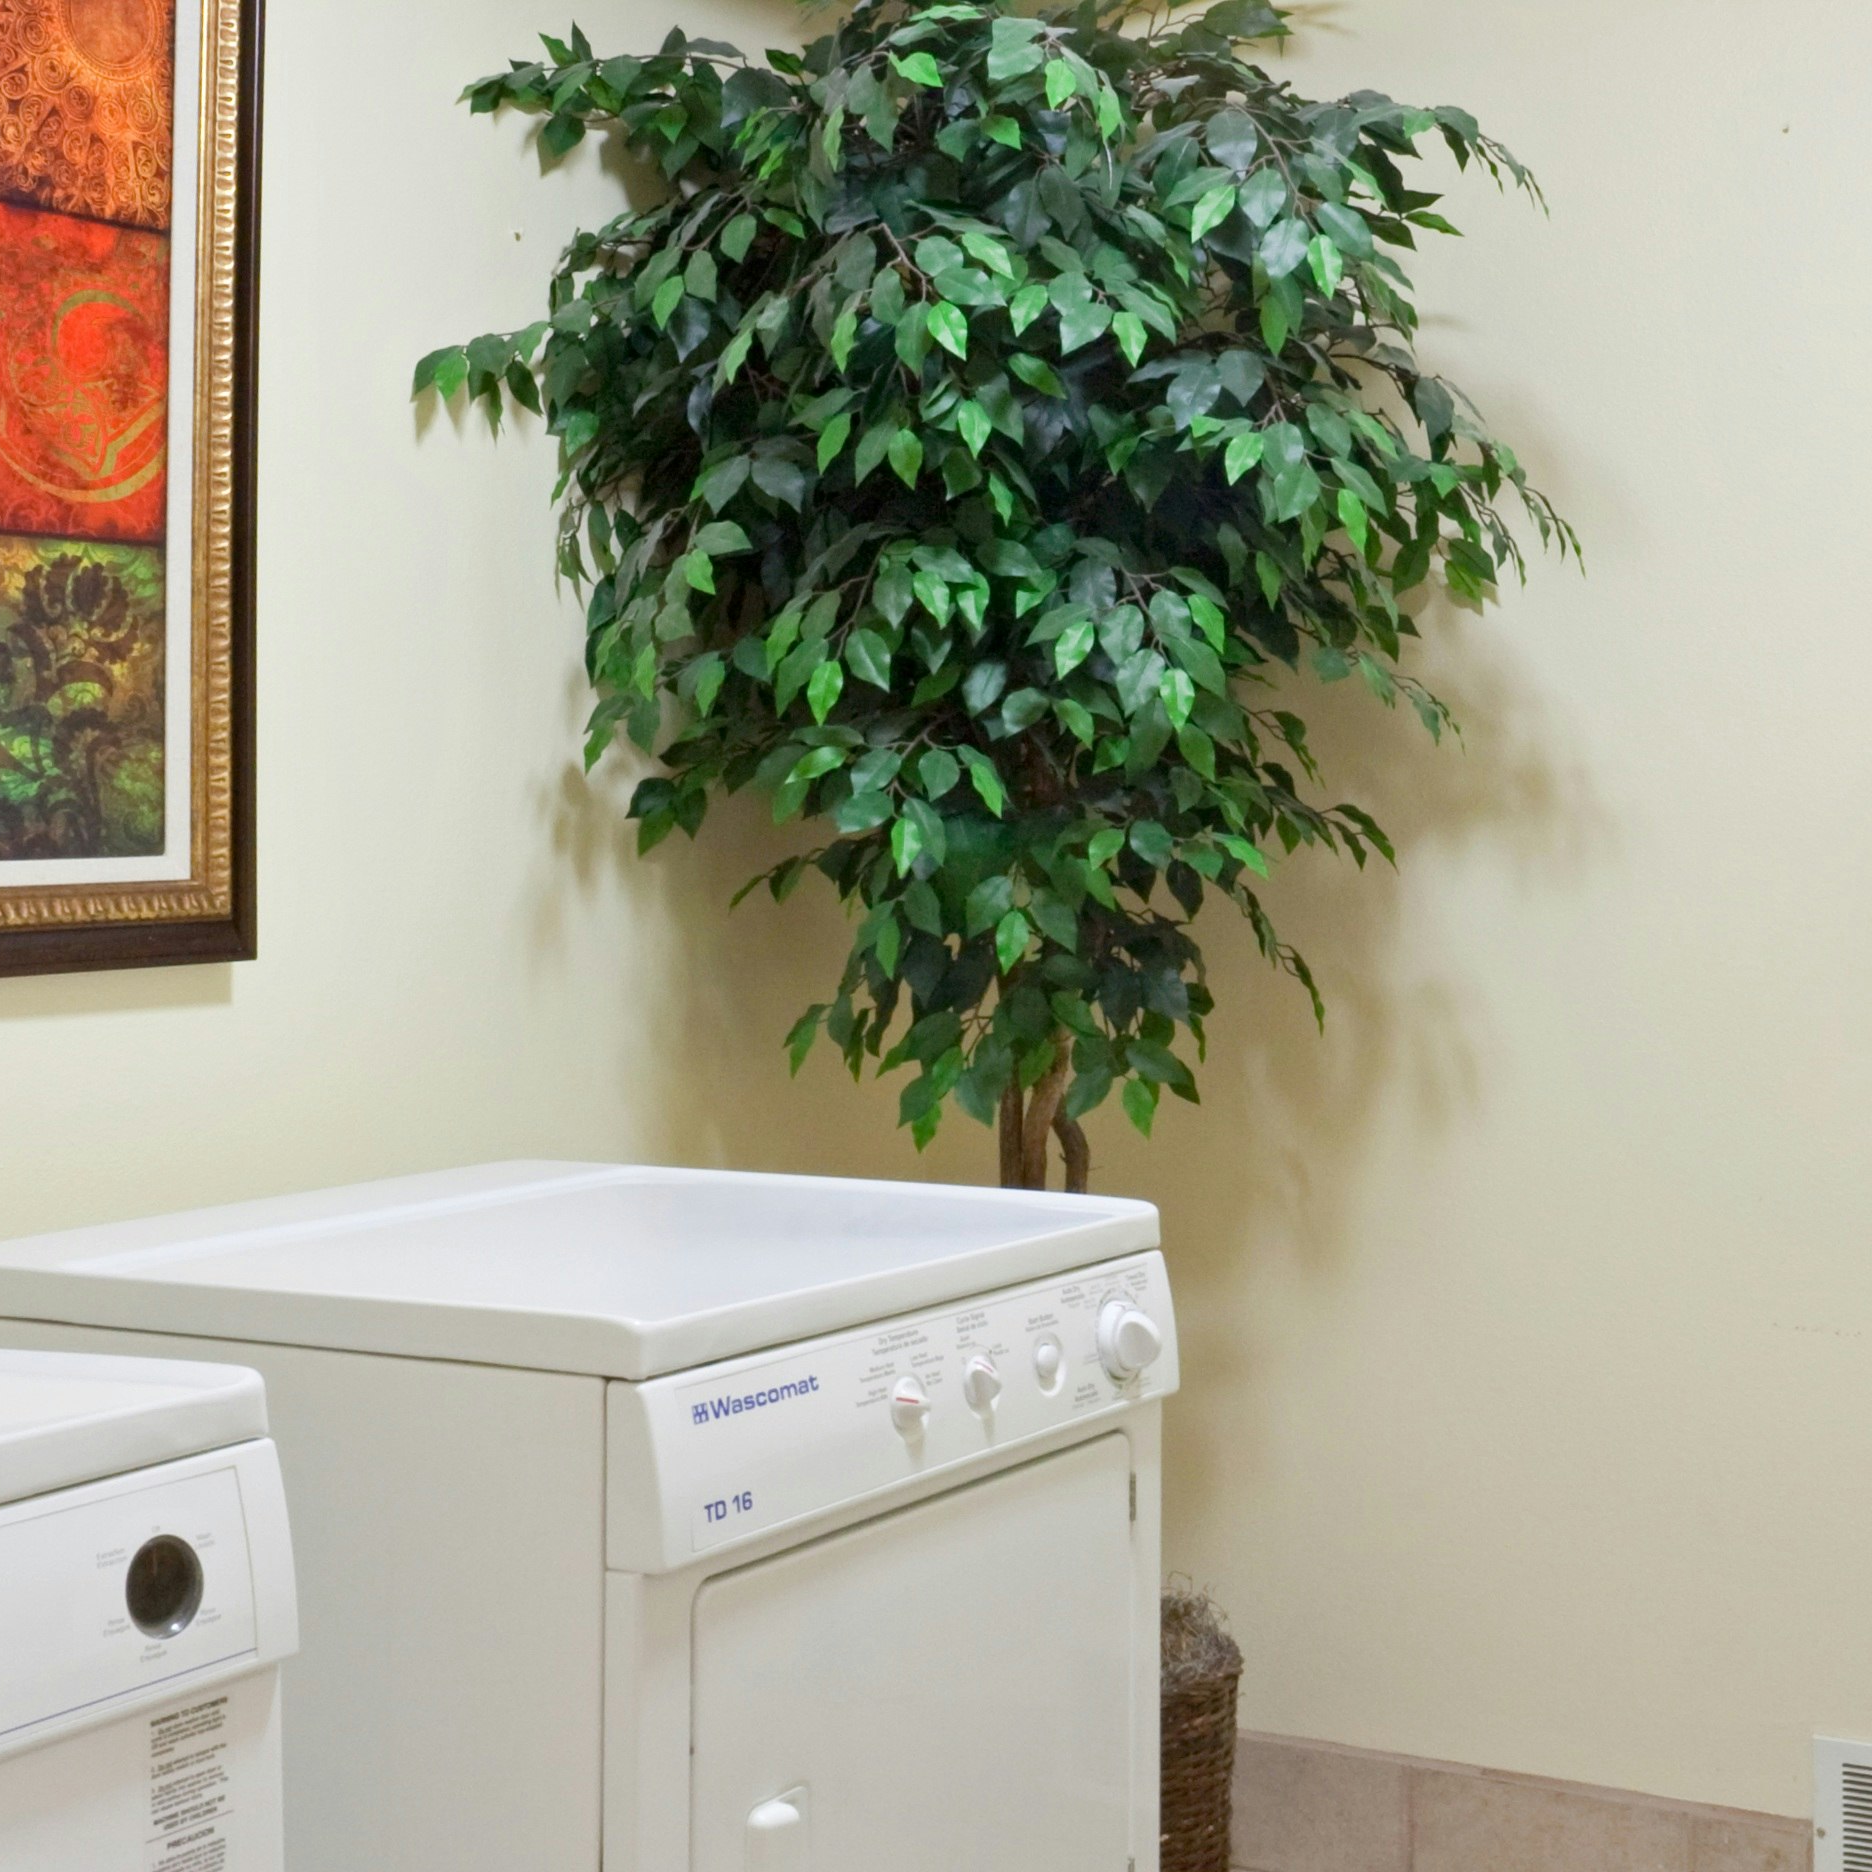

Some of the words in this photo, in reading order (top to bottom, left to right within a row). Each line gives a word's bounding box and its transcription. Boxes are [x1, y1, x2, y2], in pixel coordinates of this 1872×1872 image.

[709, 1375, 819, 1420] Wascomat
[704, 1499, 727, 1523] TD
[732, 1490, 753, 1513] 16
